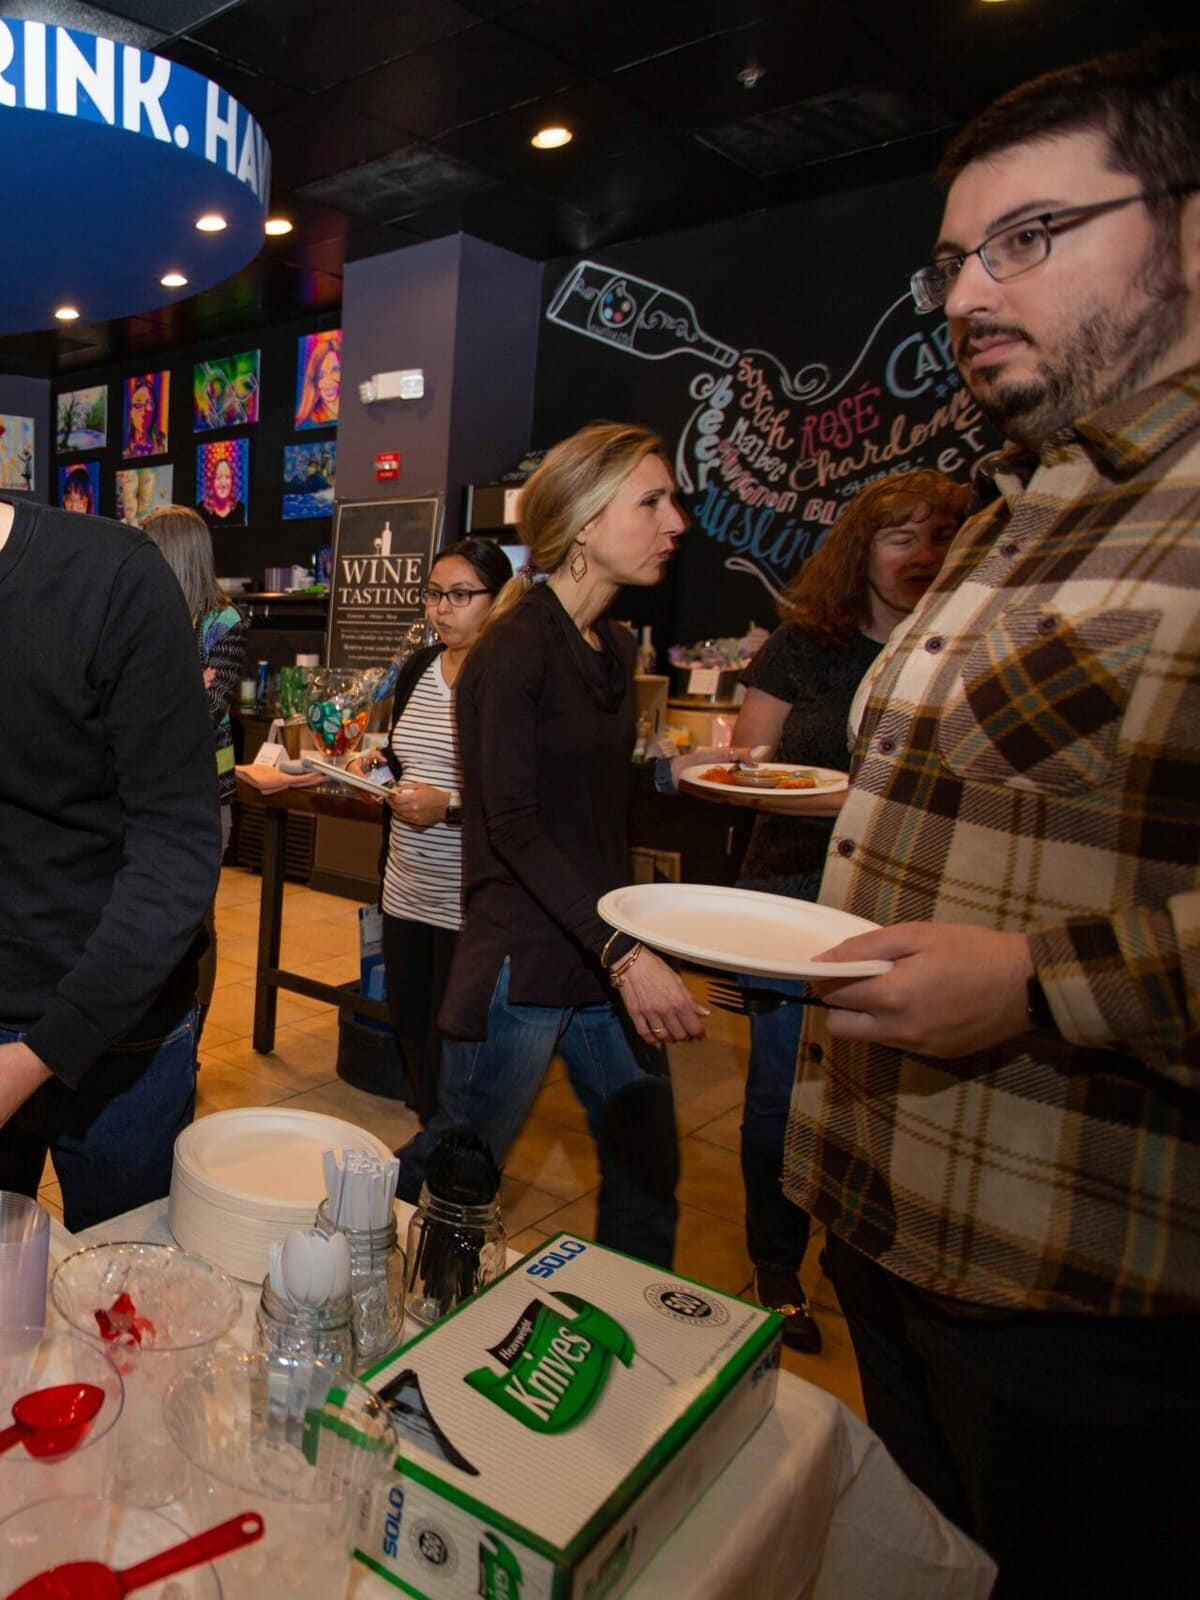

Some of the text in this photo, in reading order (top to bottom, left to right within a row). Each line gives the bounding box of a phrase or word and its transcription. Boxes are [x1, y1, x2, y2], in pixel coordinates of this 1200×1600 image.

[341, 558, 422, 585] WINE
[338, 587, 425, 606] TASTING
[526, 1239, 587, 1279] SOLO
[503, 1326, 592, 1422] Knives
[382, 1487, 405, 1560] SOLO
